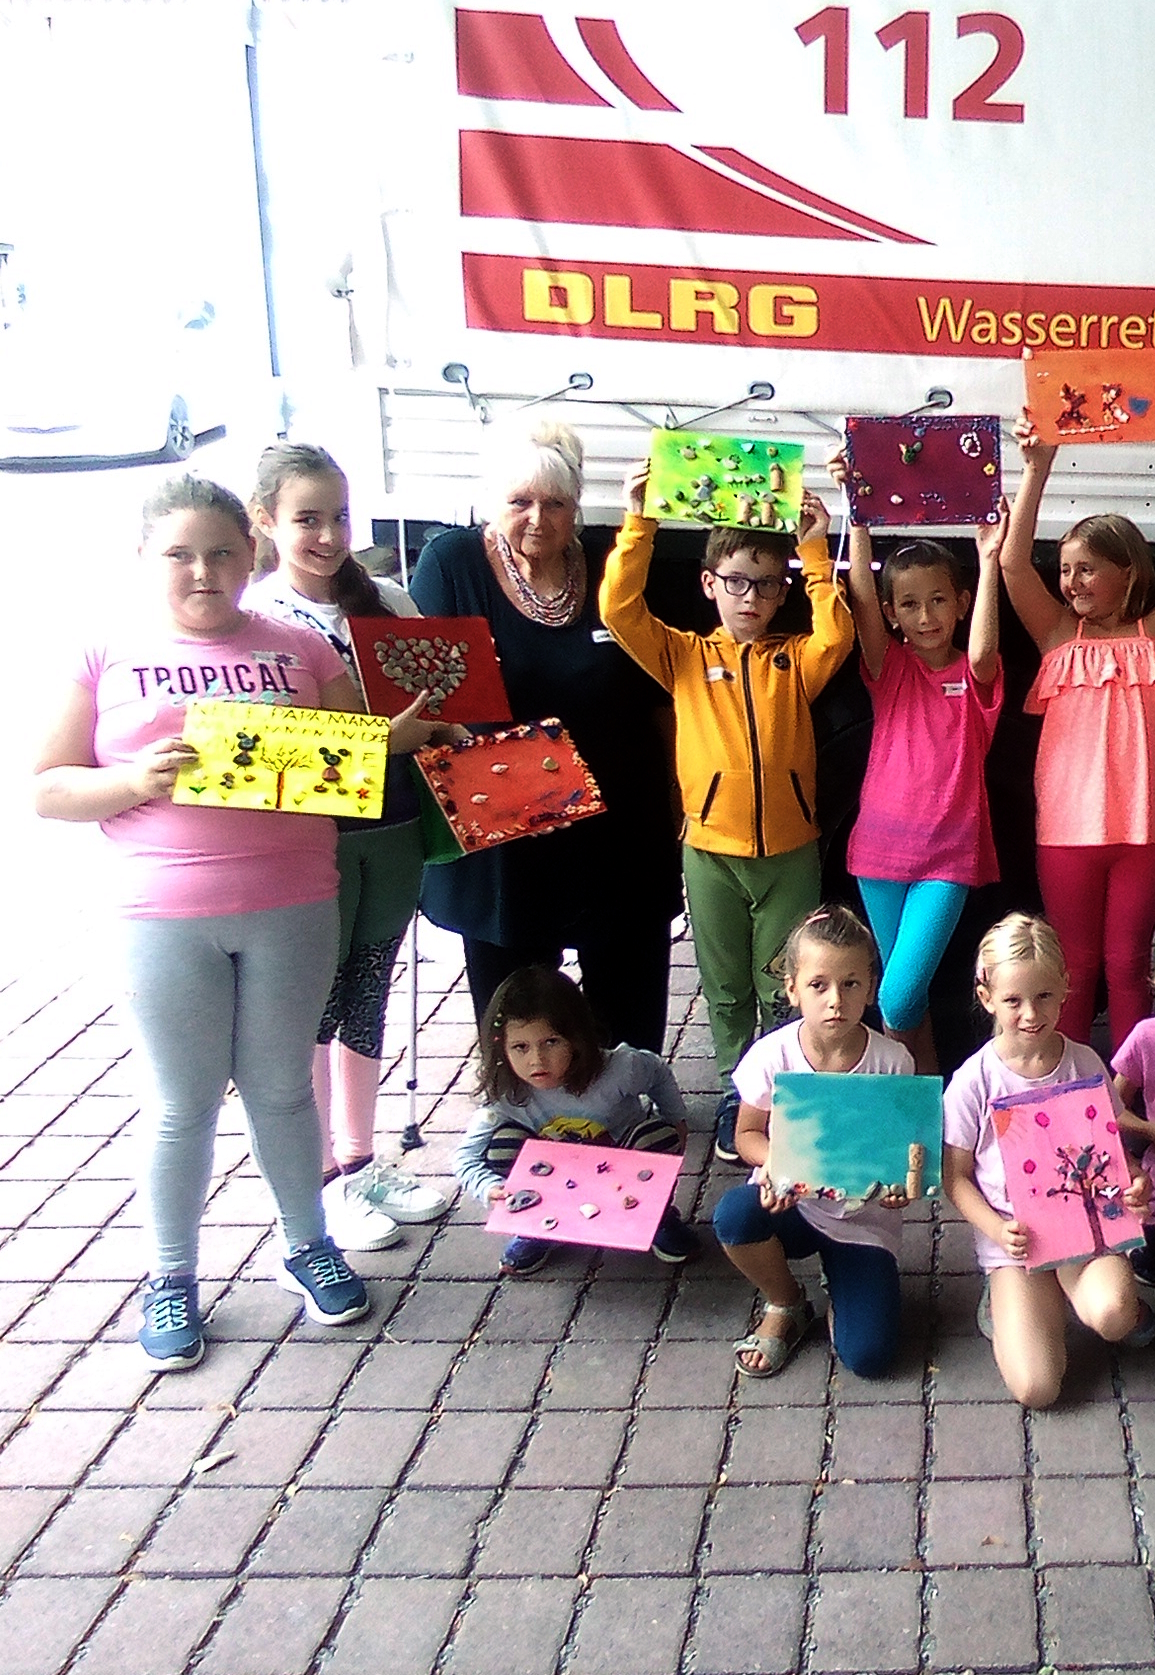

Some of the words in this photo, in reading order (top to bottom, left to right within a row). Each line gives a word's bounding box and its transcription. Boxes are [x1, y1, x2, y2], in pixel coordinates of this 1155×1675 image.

[794, 6, 1025, 123] 112
[522, 267, 820, 338] DLRG
[132, 662, 299, 697] TROPICAL
